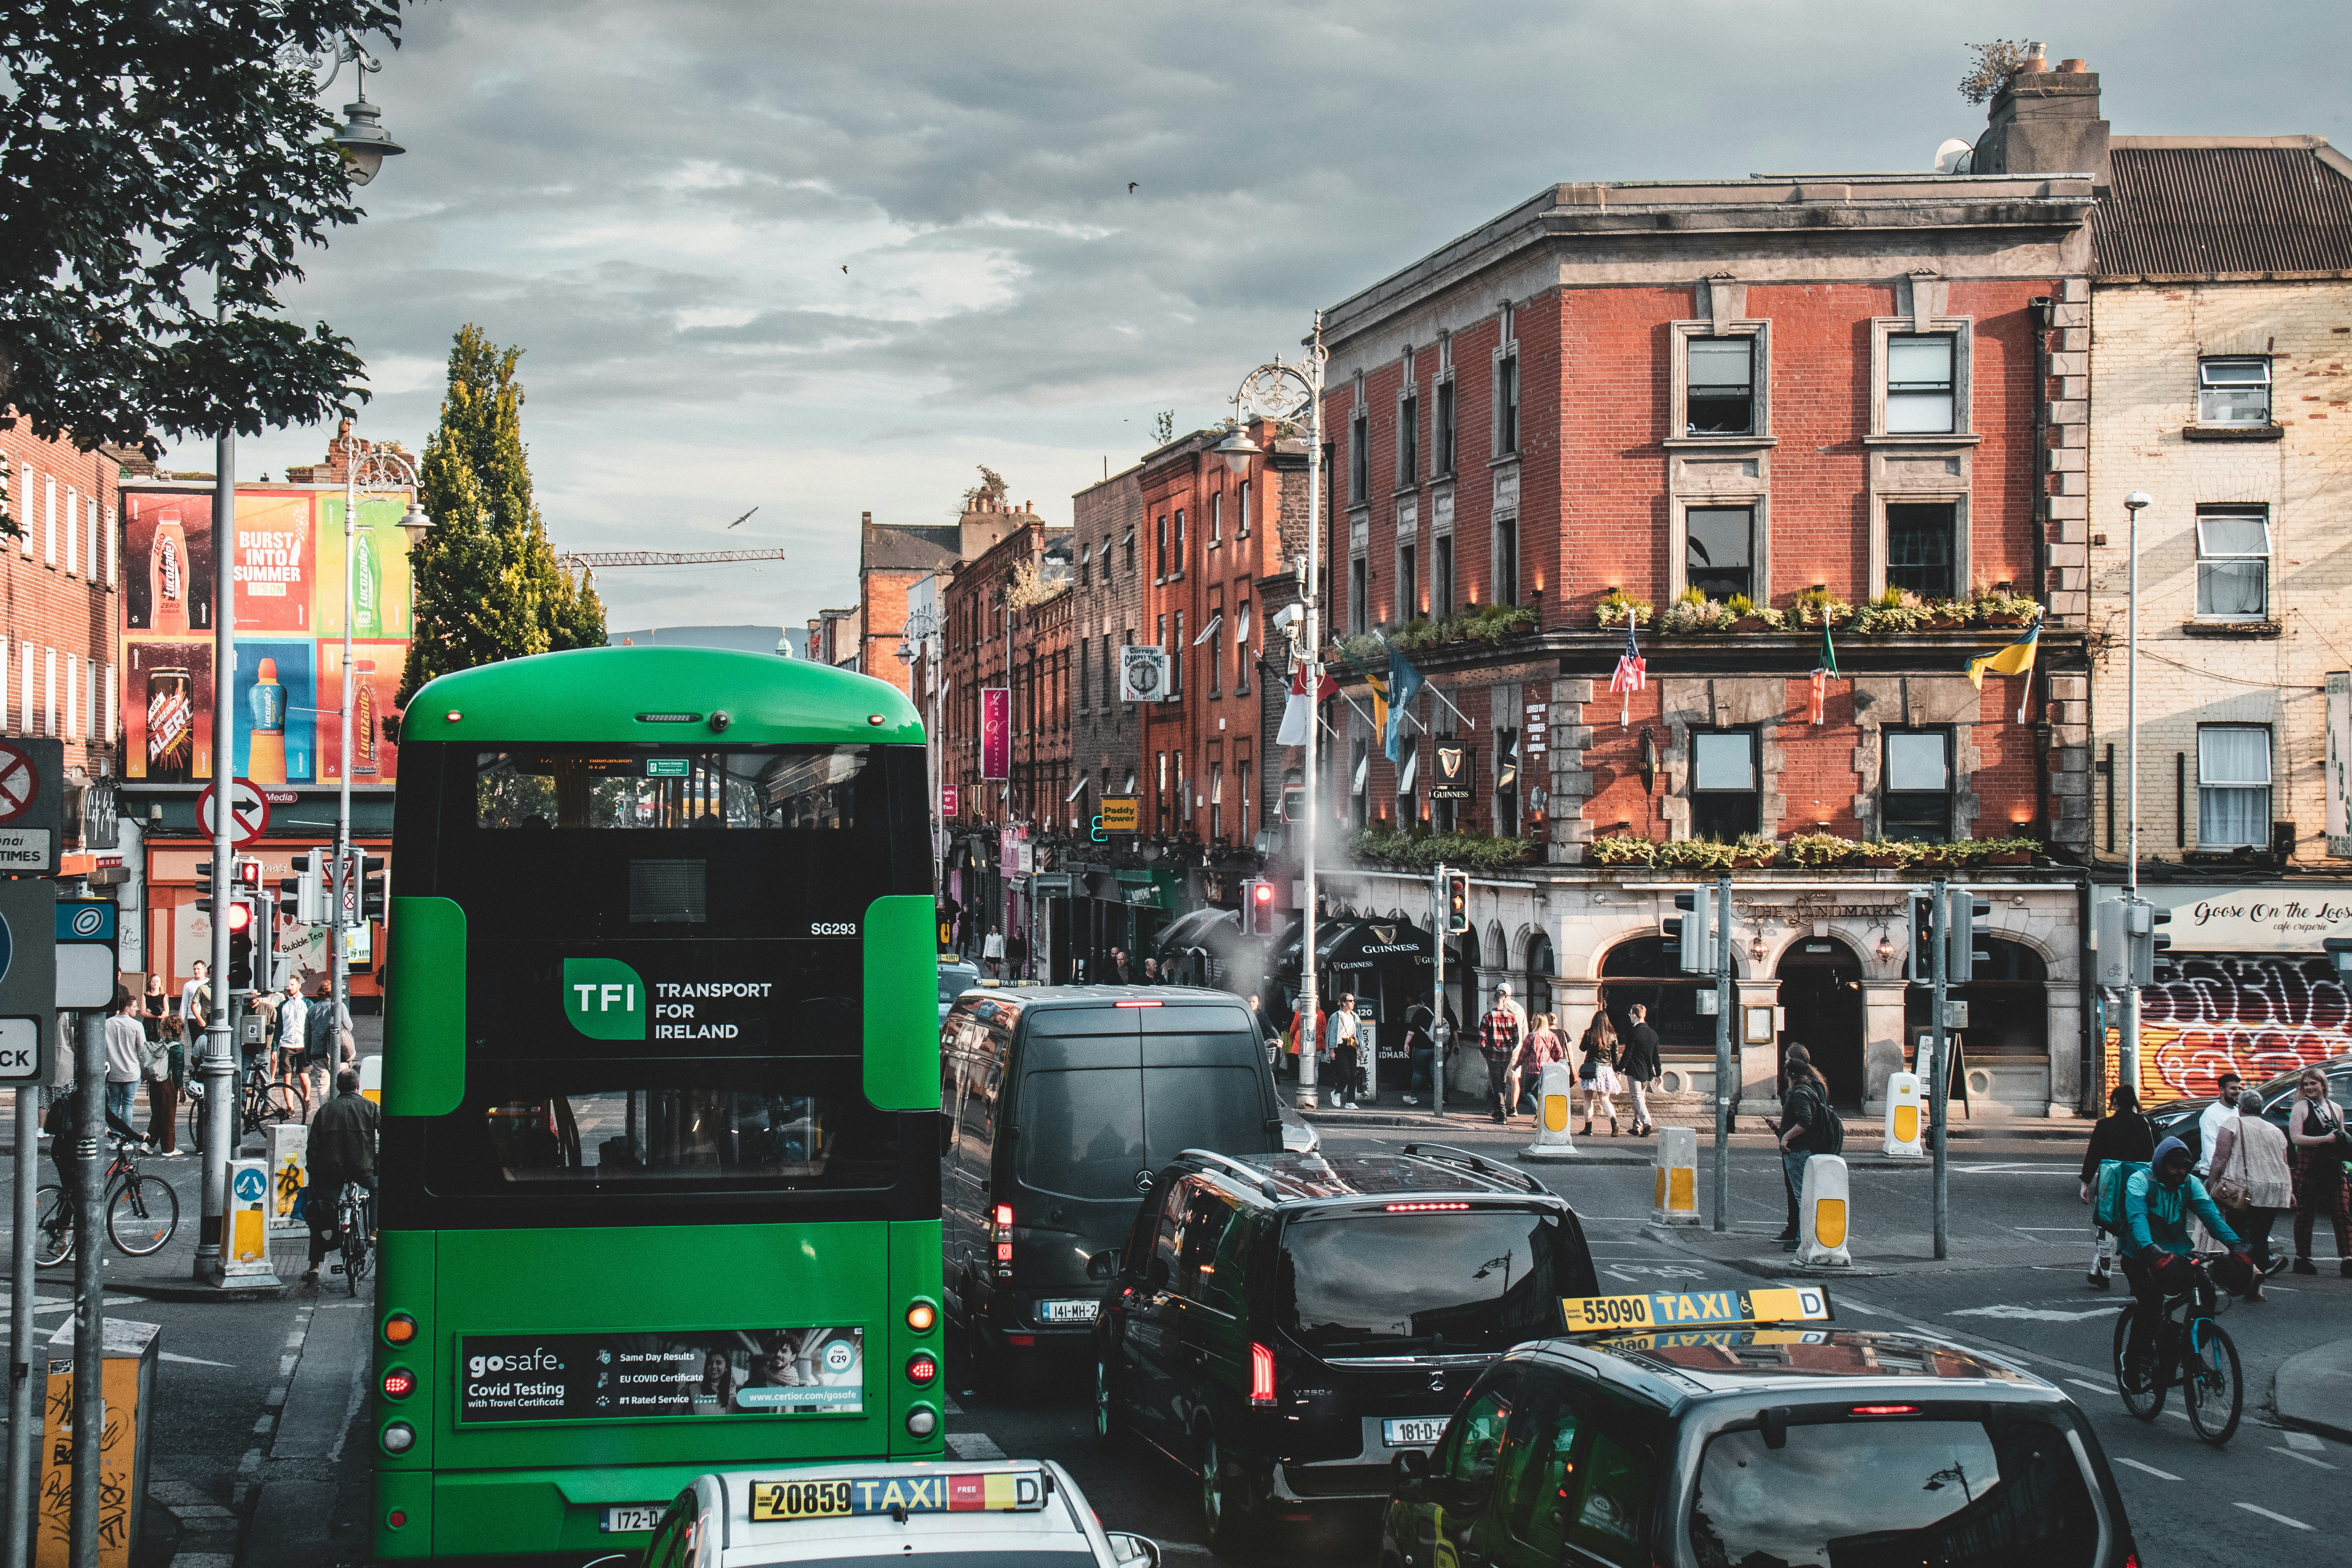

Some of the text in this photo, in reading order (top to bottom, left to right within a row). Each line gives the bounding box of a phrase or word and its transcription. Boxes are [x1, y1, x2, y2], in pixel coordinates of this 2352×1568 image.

[239, 532, 294, 549] BURST
[246, 549, 287, 566] INTO
[163, 545, 174, 598] Lucozade
[234, 566, 300, 581] SUMMER
[358, 547, 369, 608] Lucozade
[250, 584, 284, 594] IT'S ON
[1125, 655, 1146, 667] CARPET
[1148, 655, 1162, 667] TIME
[151, 698, 161, 715] NEW
[152, 699, 177, 732] Lucozade
[151, 698, 193, 761] ALERT
[358, 691, 369, 760] Lucozade
[165, 727, 188, 755] ORIGINAL
[266, 793, 293, 801] Media
[1104, 807, 1134, 816] Paddy
[0, 851, 41, 862] TIMES
[1752, 898, 1896, 927] THE LANDMARK
[2194, 902, 2245, 926] Goose
[2250, 904, 2282, 922] On
[811, 923, 856, 935] SG293
[2273, 921, 2291, 933] café
[282, 932, 324, 953] Bubble Tea
[1362, 943, 1419, 953] GUINNESS
[1340, 961, 1373, 969] GUINNESS
[574, 984, 634, 1011] TFI
[656, 984, 772, 997] TRANSPORT
[656, 1005, 694, 1018] FOR
[656, 1025, 739, 1039] IRELAND
[1055, 1305, 1097, 1318] 141-MH-2
[1583, 1293, 1820, 1324] 55090 TAXI D
[469, 1347, 565, 1378] gosafe.
[620, 1352, 695, 1363] Same Day Results
[830, 1355, 847, 1363] €29
[660, 1373, 704, 1382] Certificate
[468, 1382, 564, 1398] Covid Testing
[749, 1390, 856, 1402] www.certior.com/gosafe
[468, 1397, 565, 1408] with Travel Certificate
[632, 1396, 656, 1404] Rated
[658, 1394, 689, 1403] Service
[771, 1482, 852, 1516] 20859
[857, 1478, 942, 1511] TAXI
[1016, 1478, 1039, 1505] D
